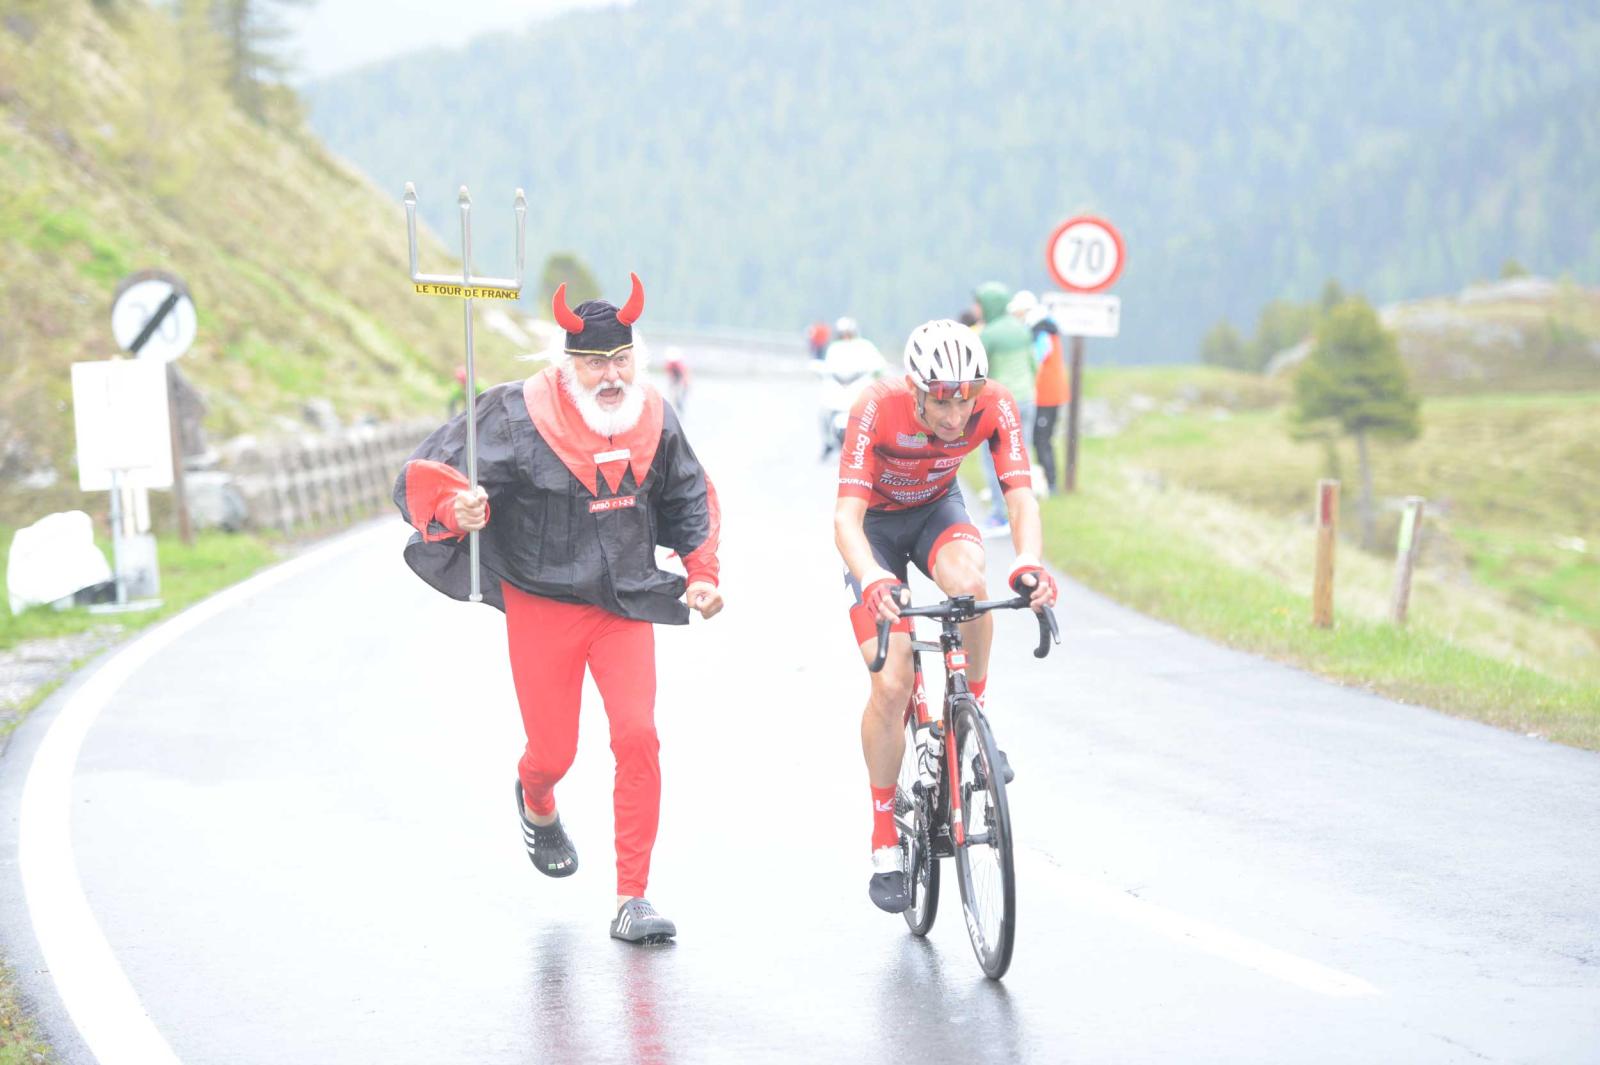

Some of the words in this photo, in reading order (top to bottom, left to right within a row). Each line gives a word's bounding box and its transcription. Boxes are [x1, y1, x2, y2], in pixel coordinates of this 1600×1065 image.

[1069, 237, 1106, 274] 70
[415, 285, 429, 293] LE
[432, 285, 461, 295] TOUR
[464, 288, 479, 297] DE
[481, 289, 520, 300] FRANCE
[618, 498, 634, 506] 1-2-3
